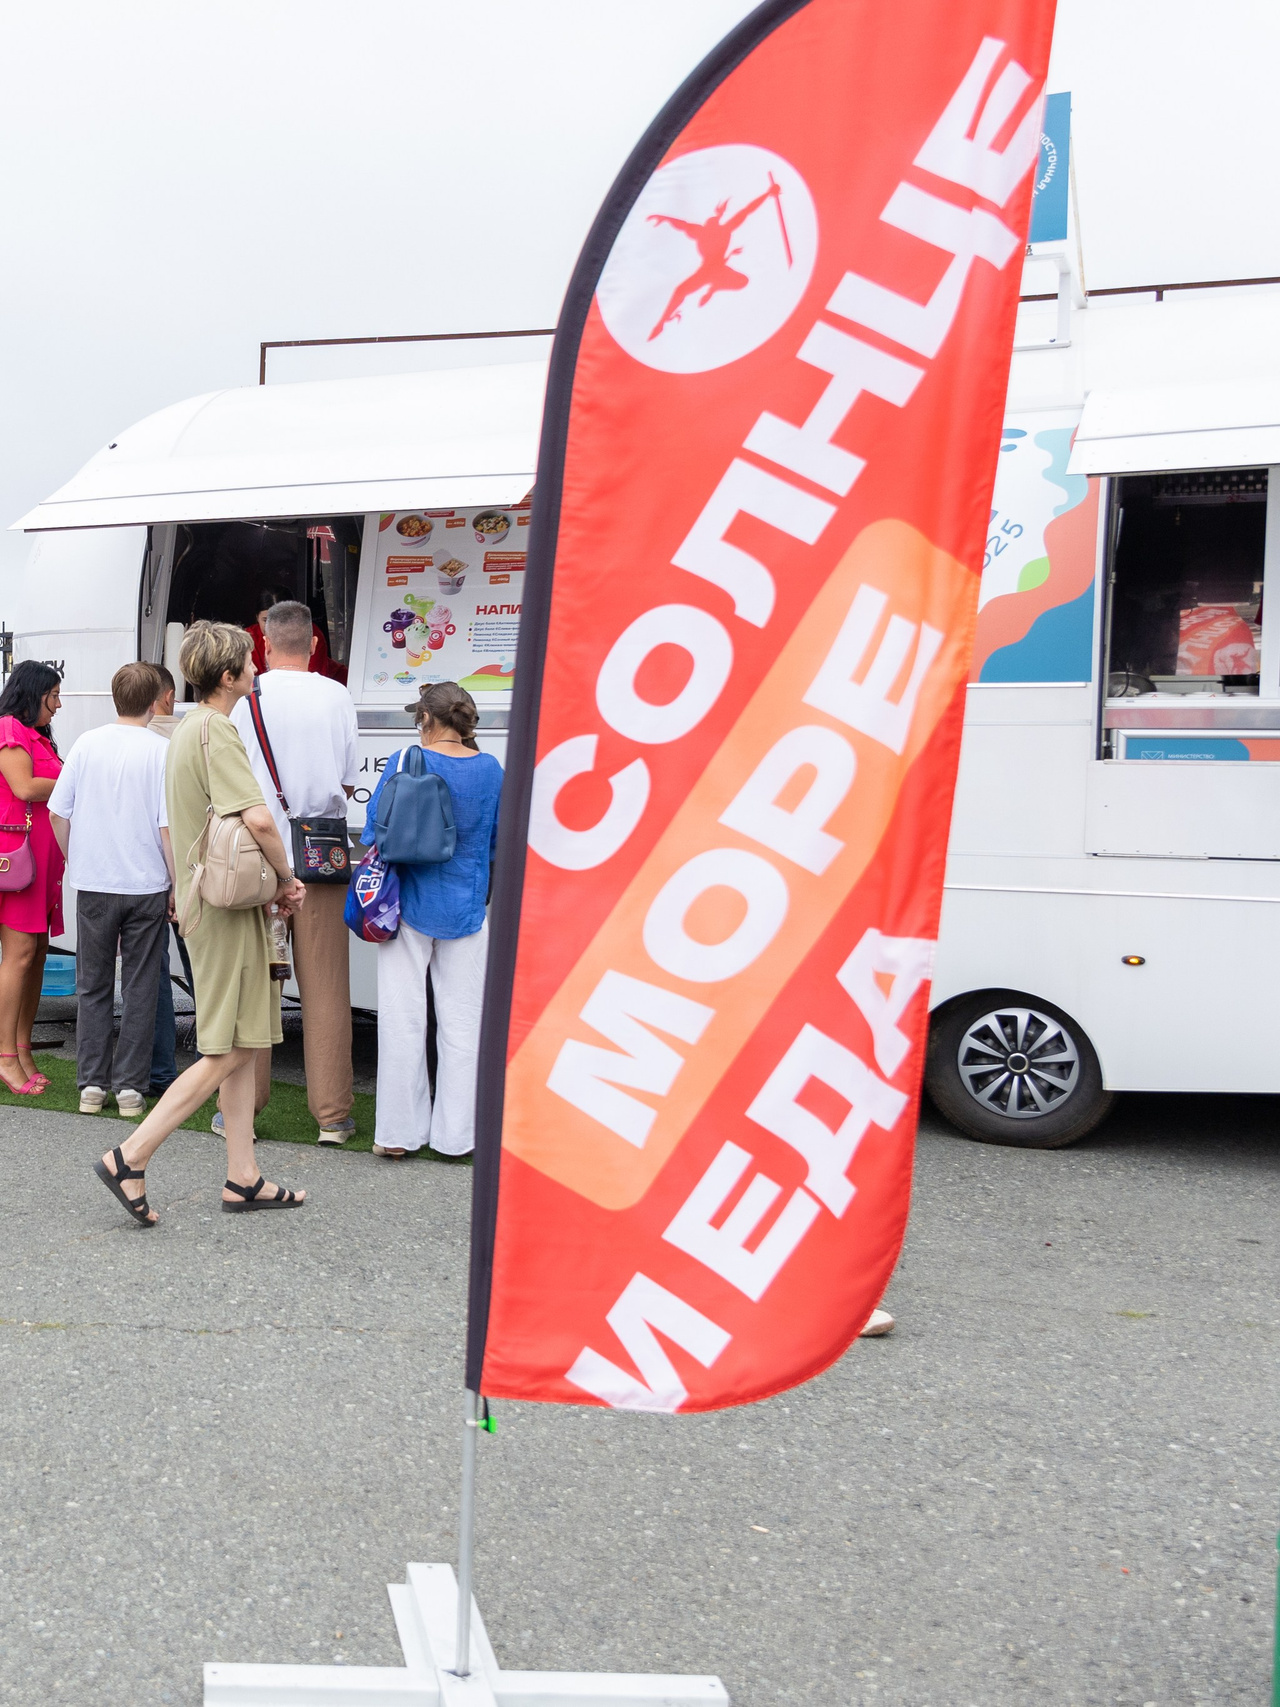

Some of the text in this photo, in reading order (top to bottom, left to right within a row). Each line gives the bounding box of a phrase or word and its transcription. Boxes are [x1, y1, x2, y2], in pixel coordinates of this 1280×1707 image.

[528, 35, 1047, 871] СОЛНЦЕ
[546, 582, 943, 1148] МОРЕ
[661, 926, 938, 1304] ЕДА
